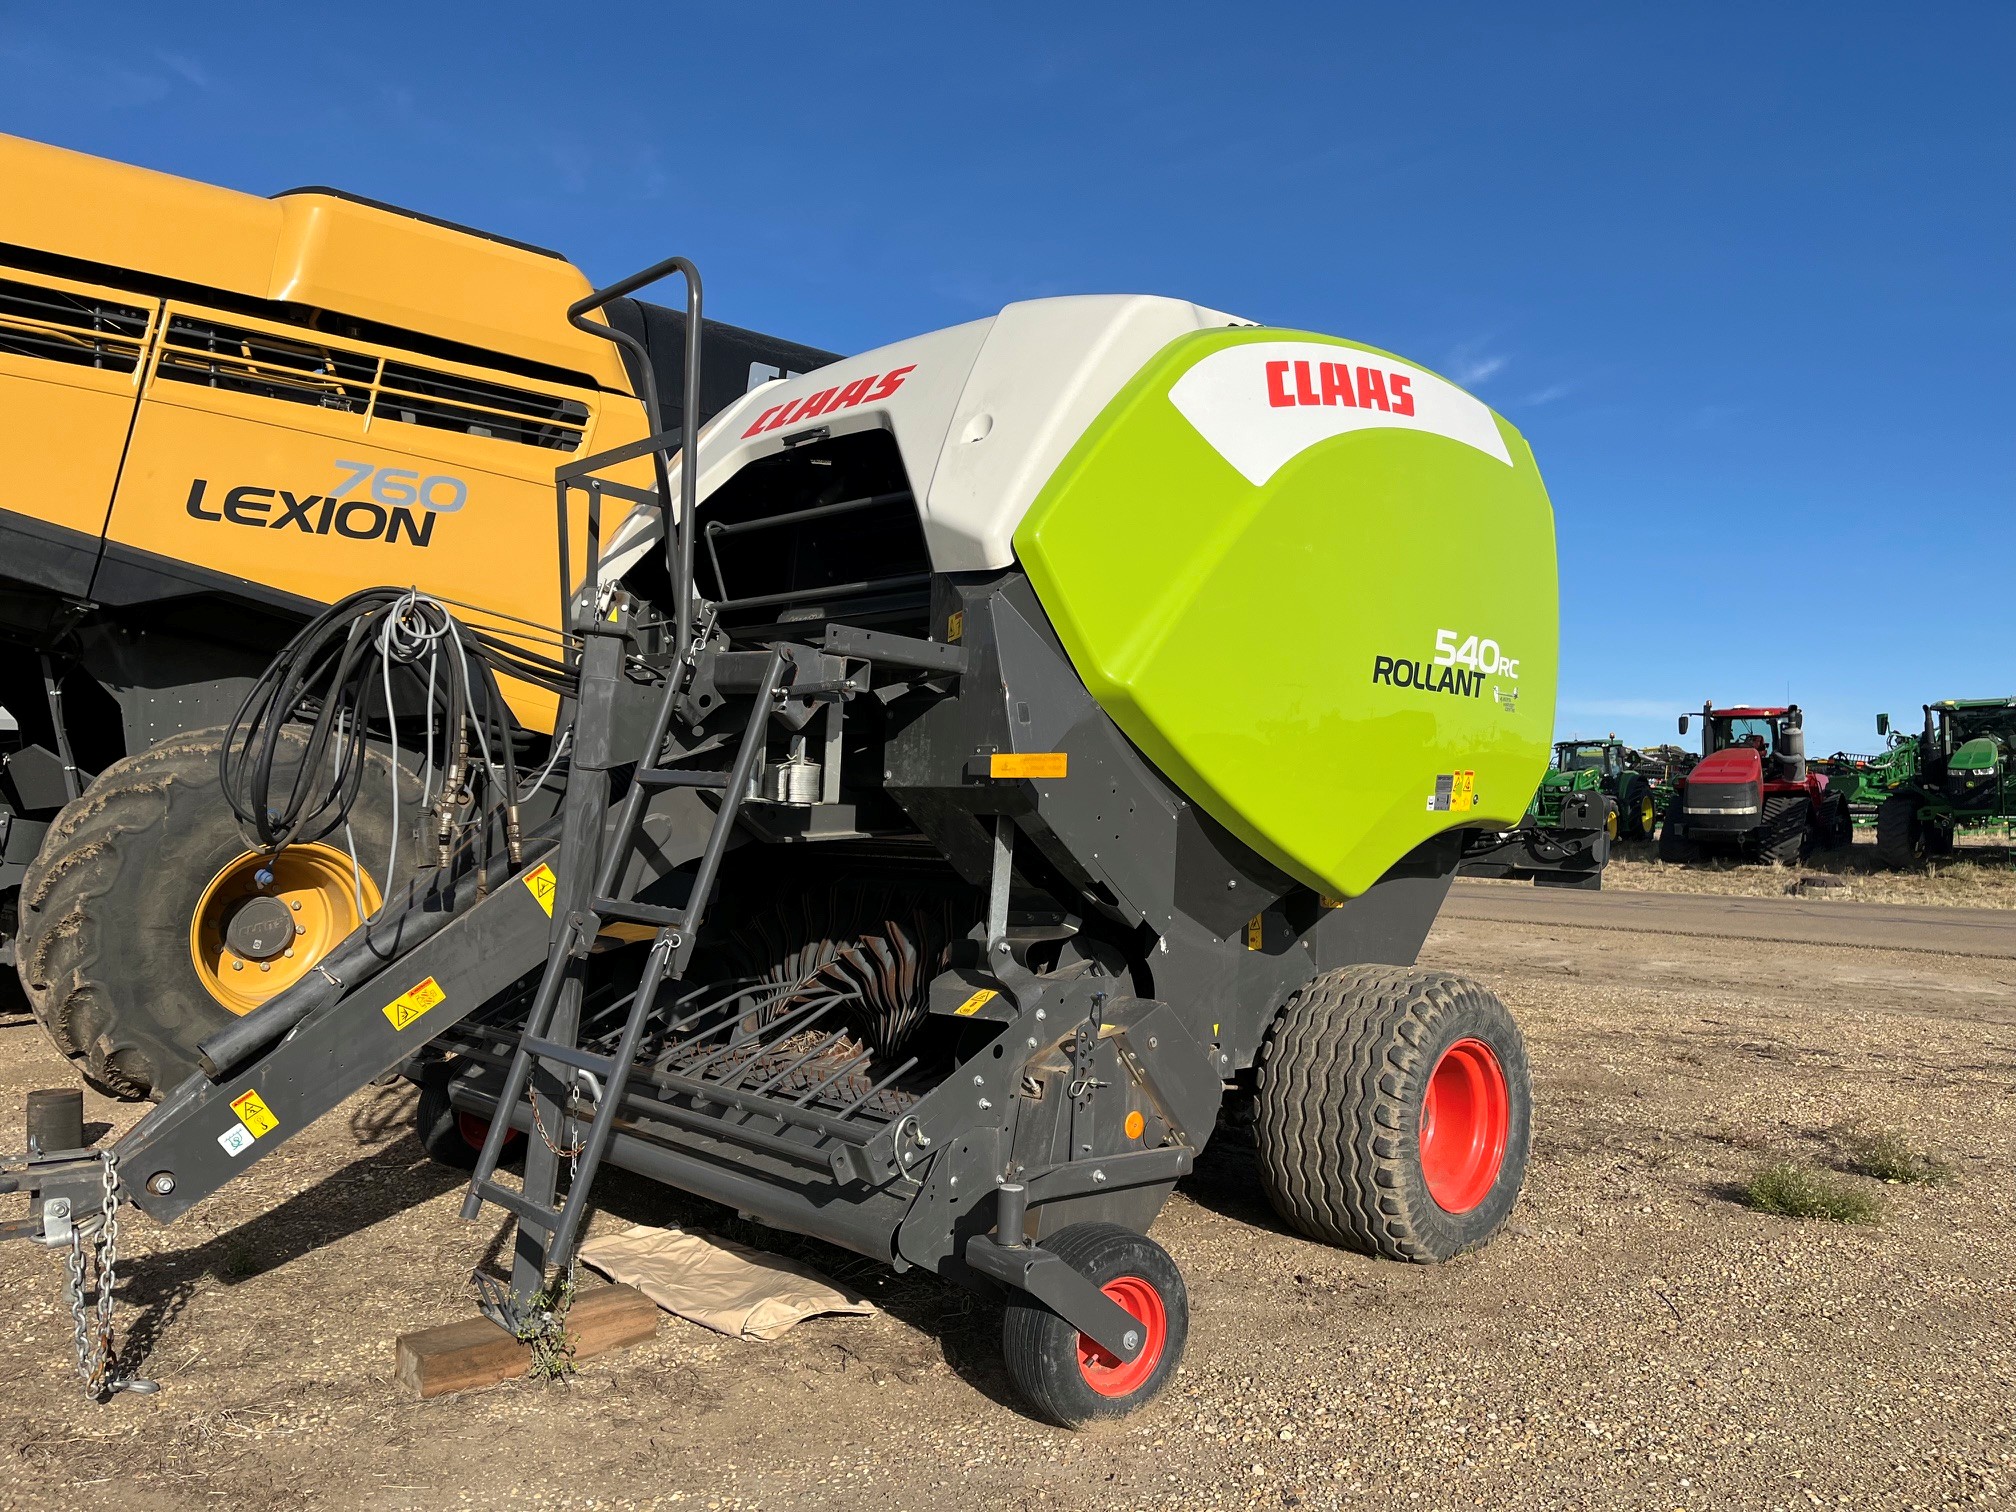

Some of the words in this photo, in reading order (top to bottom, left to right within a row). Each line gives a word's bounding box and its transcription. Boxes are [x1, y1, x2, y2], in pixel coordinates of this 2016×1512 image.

[741, 364, 918, 439] CLAAS
[1266, 360, 1415, 417] CLAAS
[186, 478, 437, 547] LEXION
[328, 459, 467, 513] 760
[1372, 655, 1486, 698] ROLLANT
